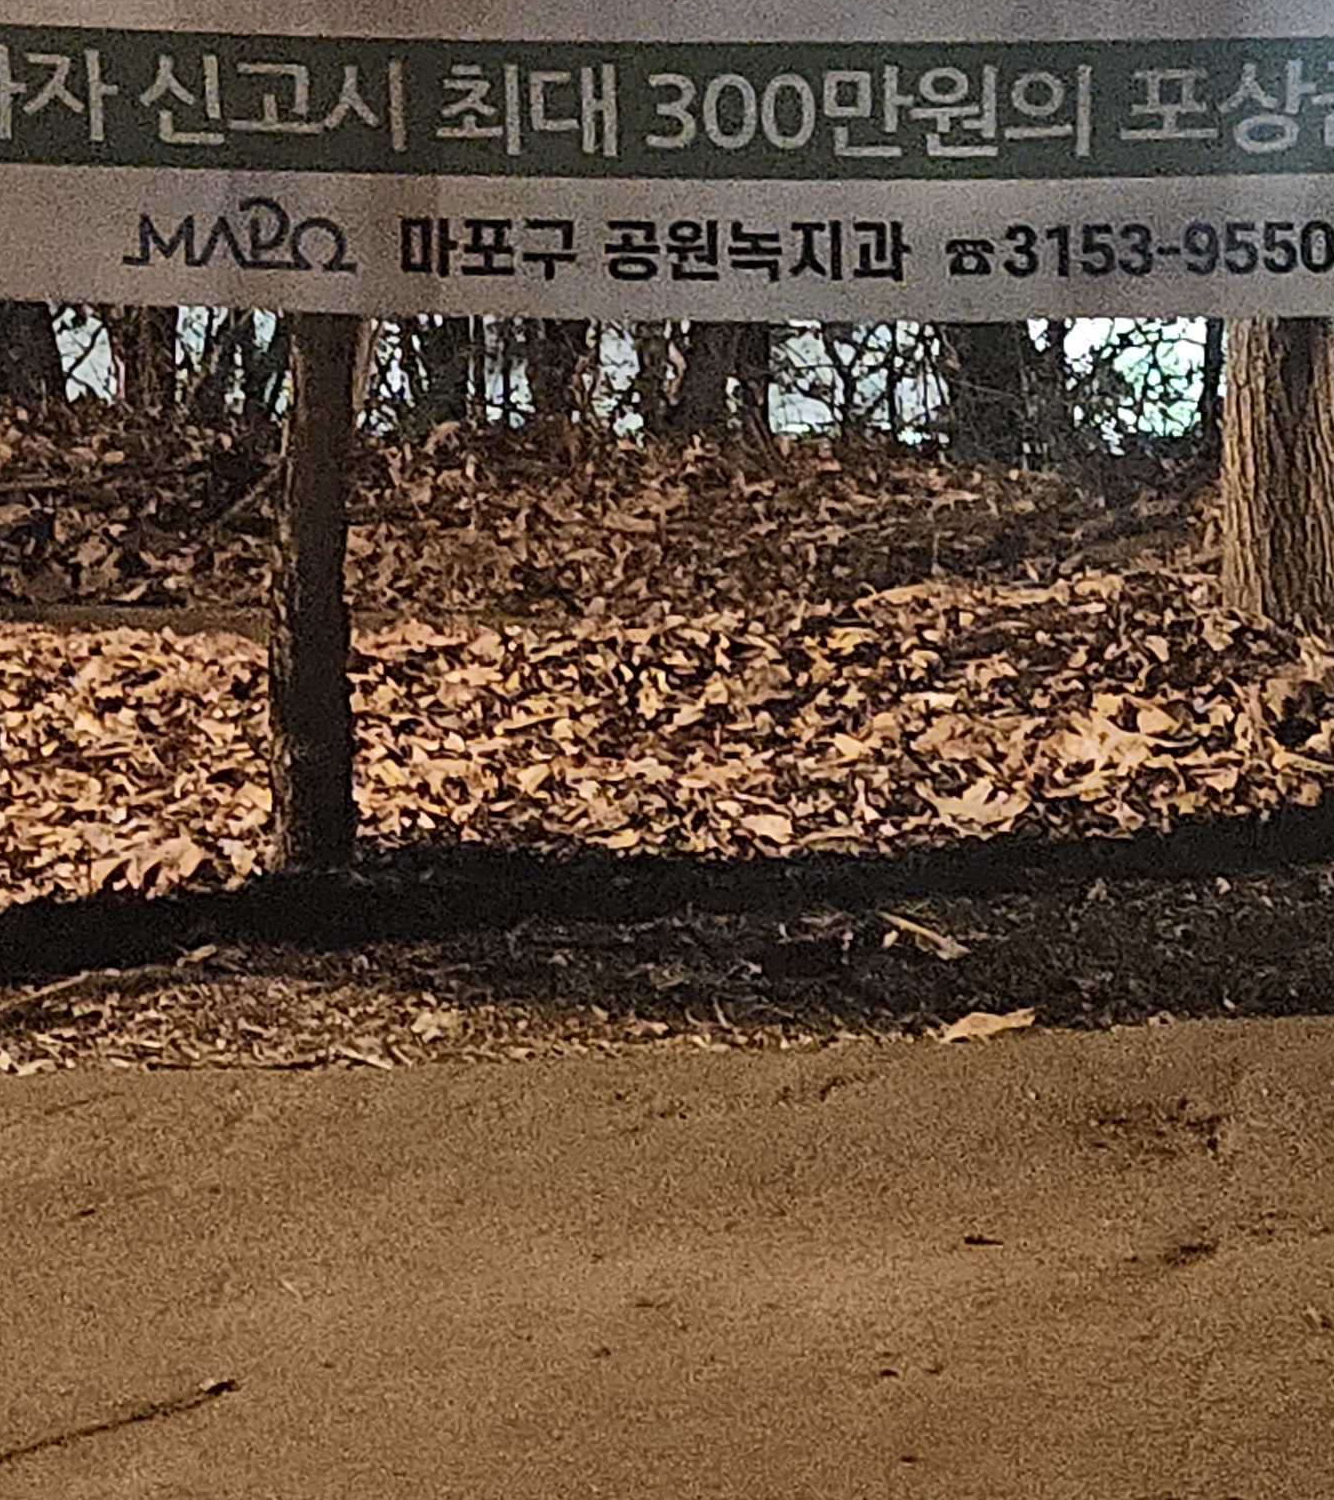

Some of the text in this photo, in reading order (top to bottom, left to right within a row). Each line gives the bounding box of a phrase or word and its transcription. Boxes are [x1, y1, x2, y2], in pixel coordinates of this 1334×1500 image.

[139, 54, 408, 153] 신고시
[436, 60, 618, 157] 최대
[645, 63, 1092, 160] 300만원의
[400, 216, 578, 280] 마포구
[604, 218, 912, 283] 공원녹지과
